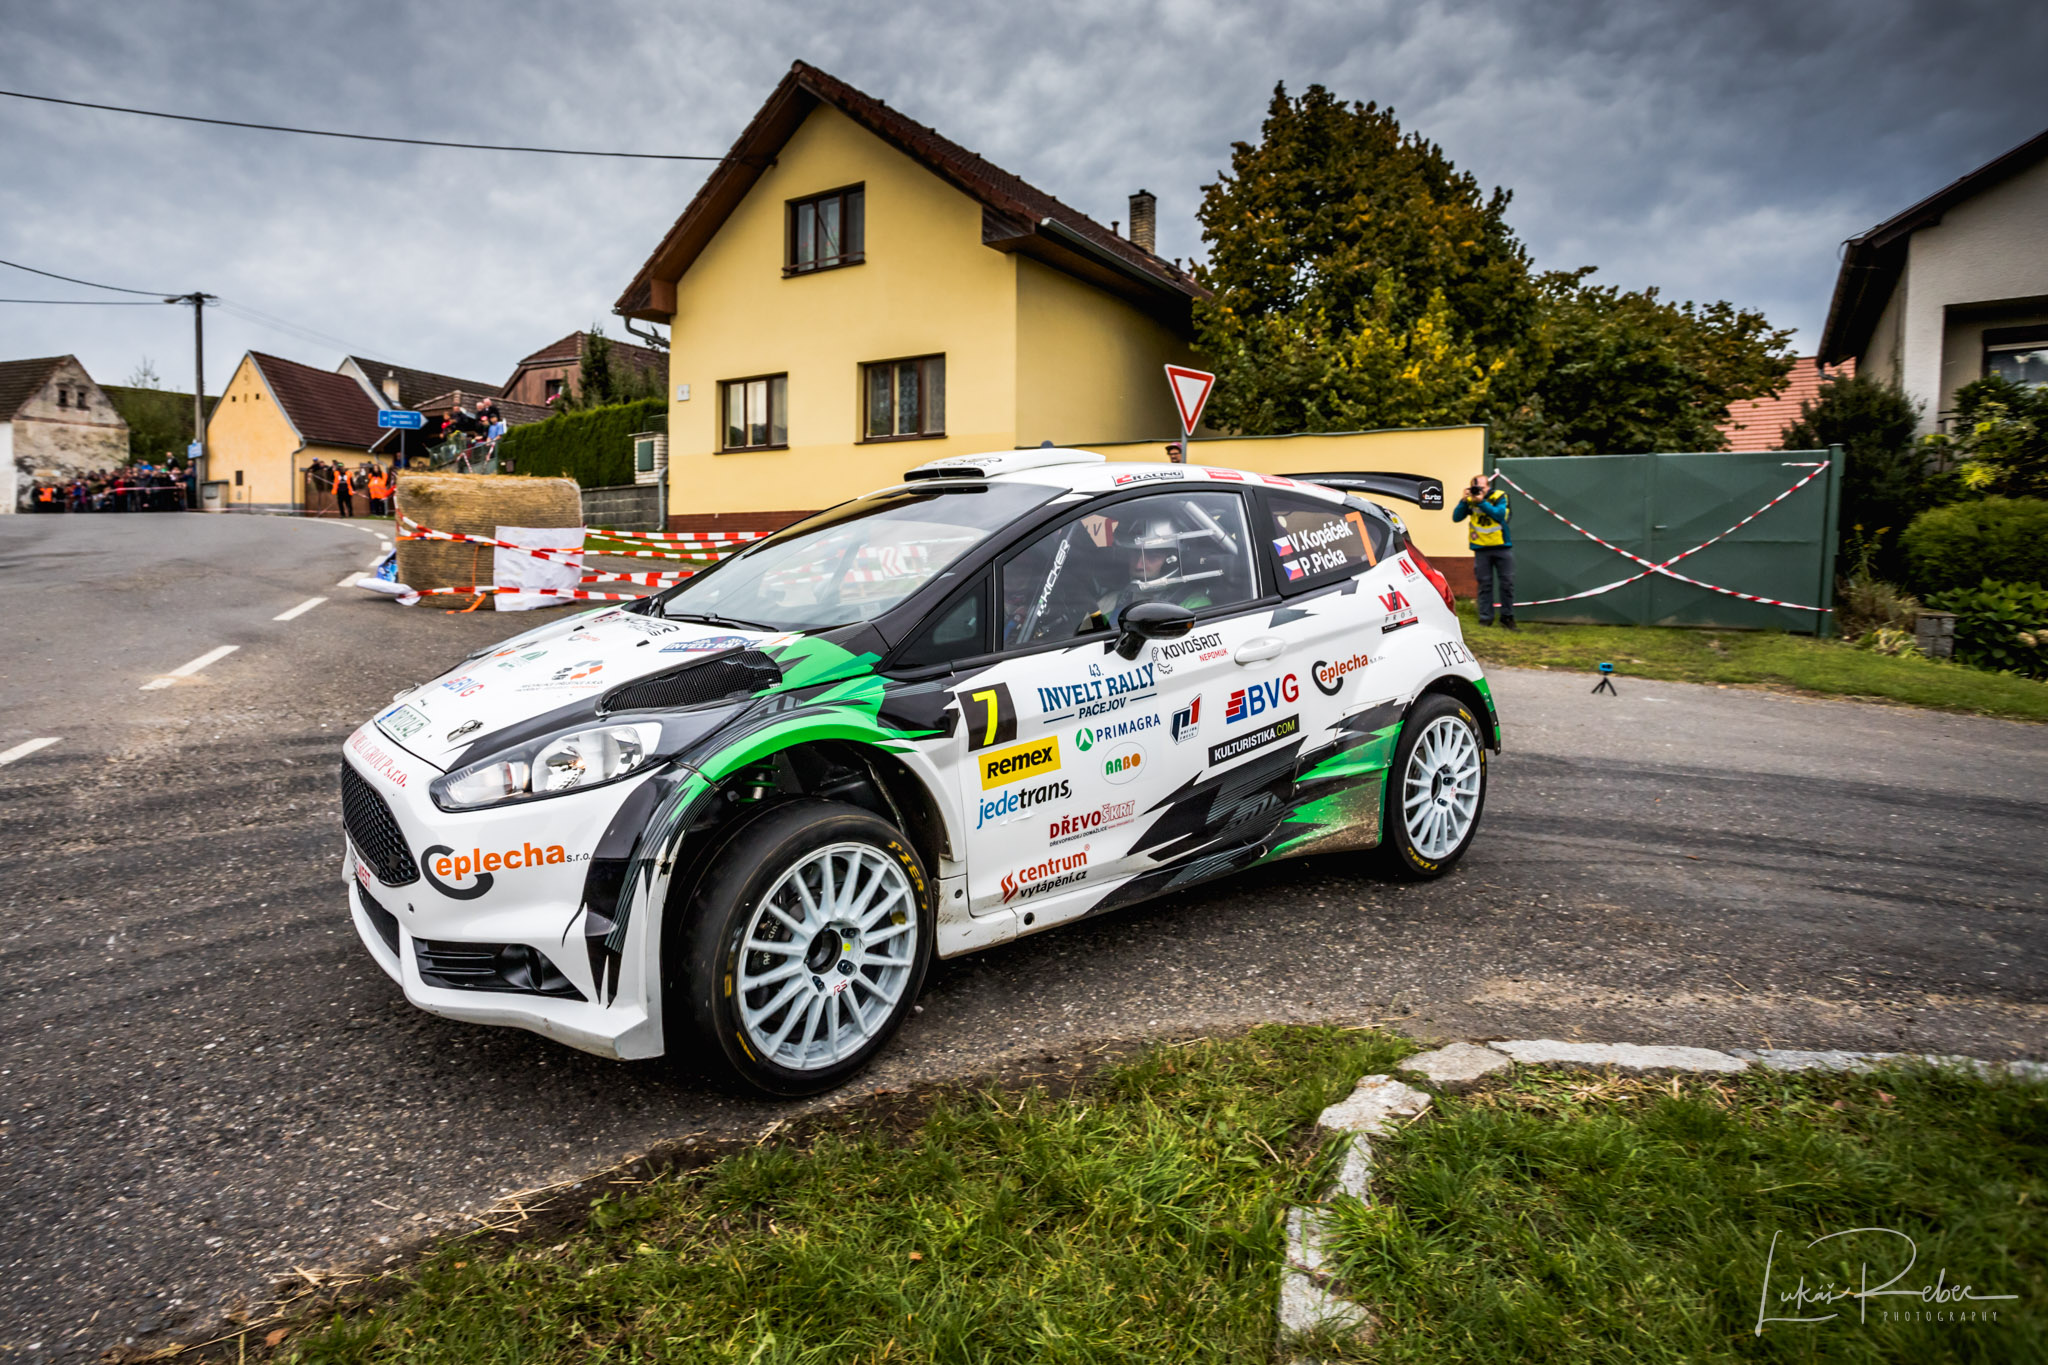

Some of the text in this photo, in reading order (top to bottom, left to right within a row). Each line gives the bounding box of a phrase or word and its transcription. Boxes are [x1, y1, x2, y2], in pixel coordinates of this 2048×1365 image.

[1287, 519, 1353, 552] V.Kopáček
[1345, 511, 1377, 566] 7
[1041, 539, 1071, 602] KICKER
[1299, 549, 1348, 576] P.Picka
[1161, 633, 1223, 660] KOVOŠROT
[1199, 648, 1228, 662] NEPOMUK
[1088, 663, 1104, 677] 43.
[1037, 663, 1155, 713] INVELT RALLY
[1248, 673, 1299, 716] BVG
[972, 689, 998, 746] 7
[1079, 697, 1127, 719] PAČEJOV
[1096, 713, 1161, 742] PRIMAGRA
[1105, 753, 1141, 775] ARBO
[1050, 800, 1135, 839] DŘEVOŠKRT
[566, 852, 591, 863] s.r.o.
[1019, 851, 1087, 884] centrum
[1020, 870, 1088, 898] vytápění.cz
